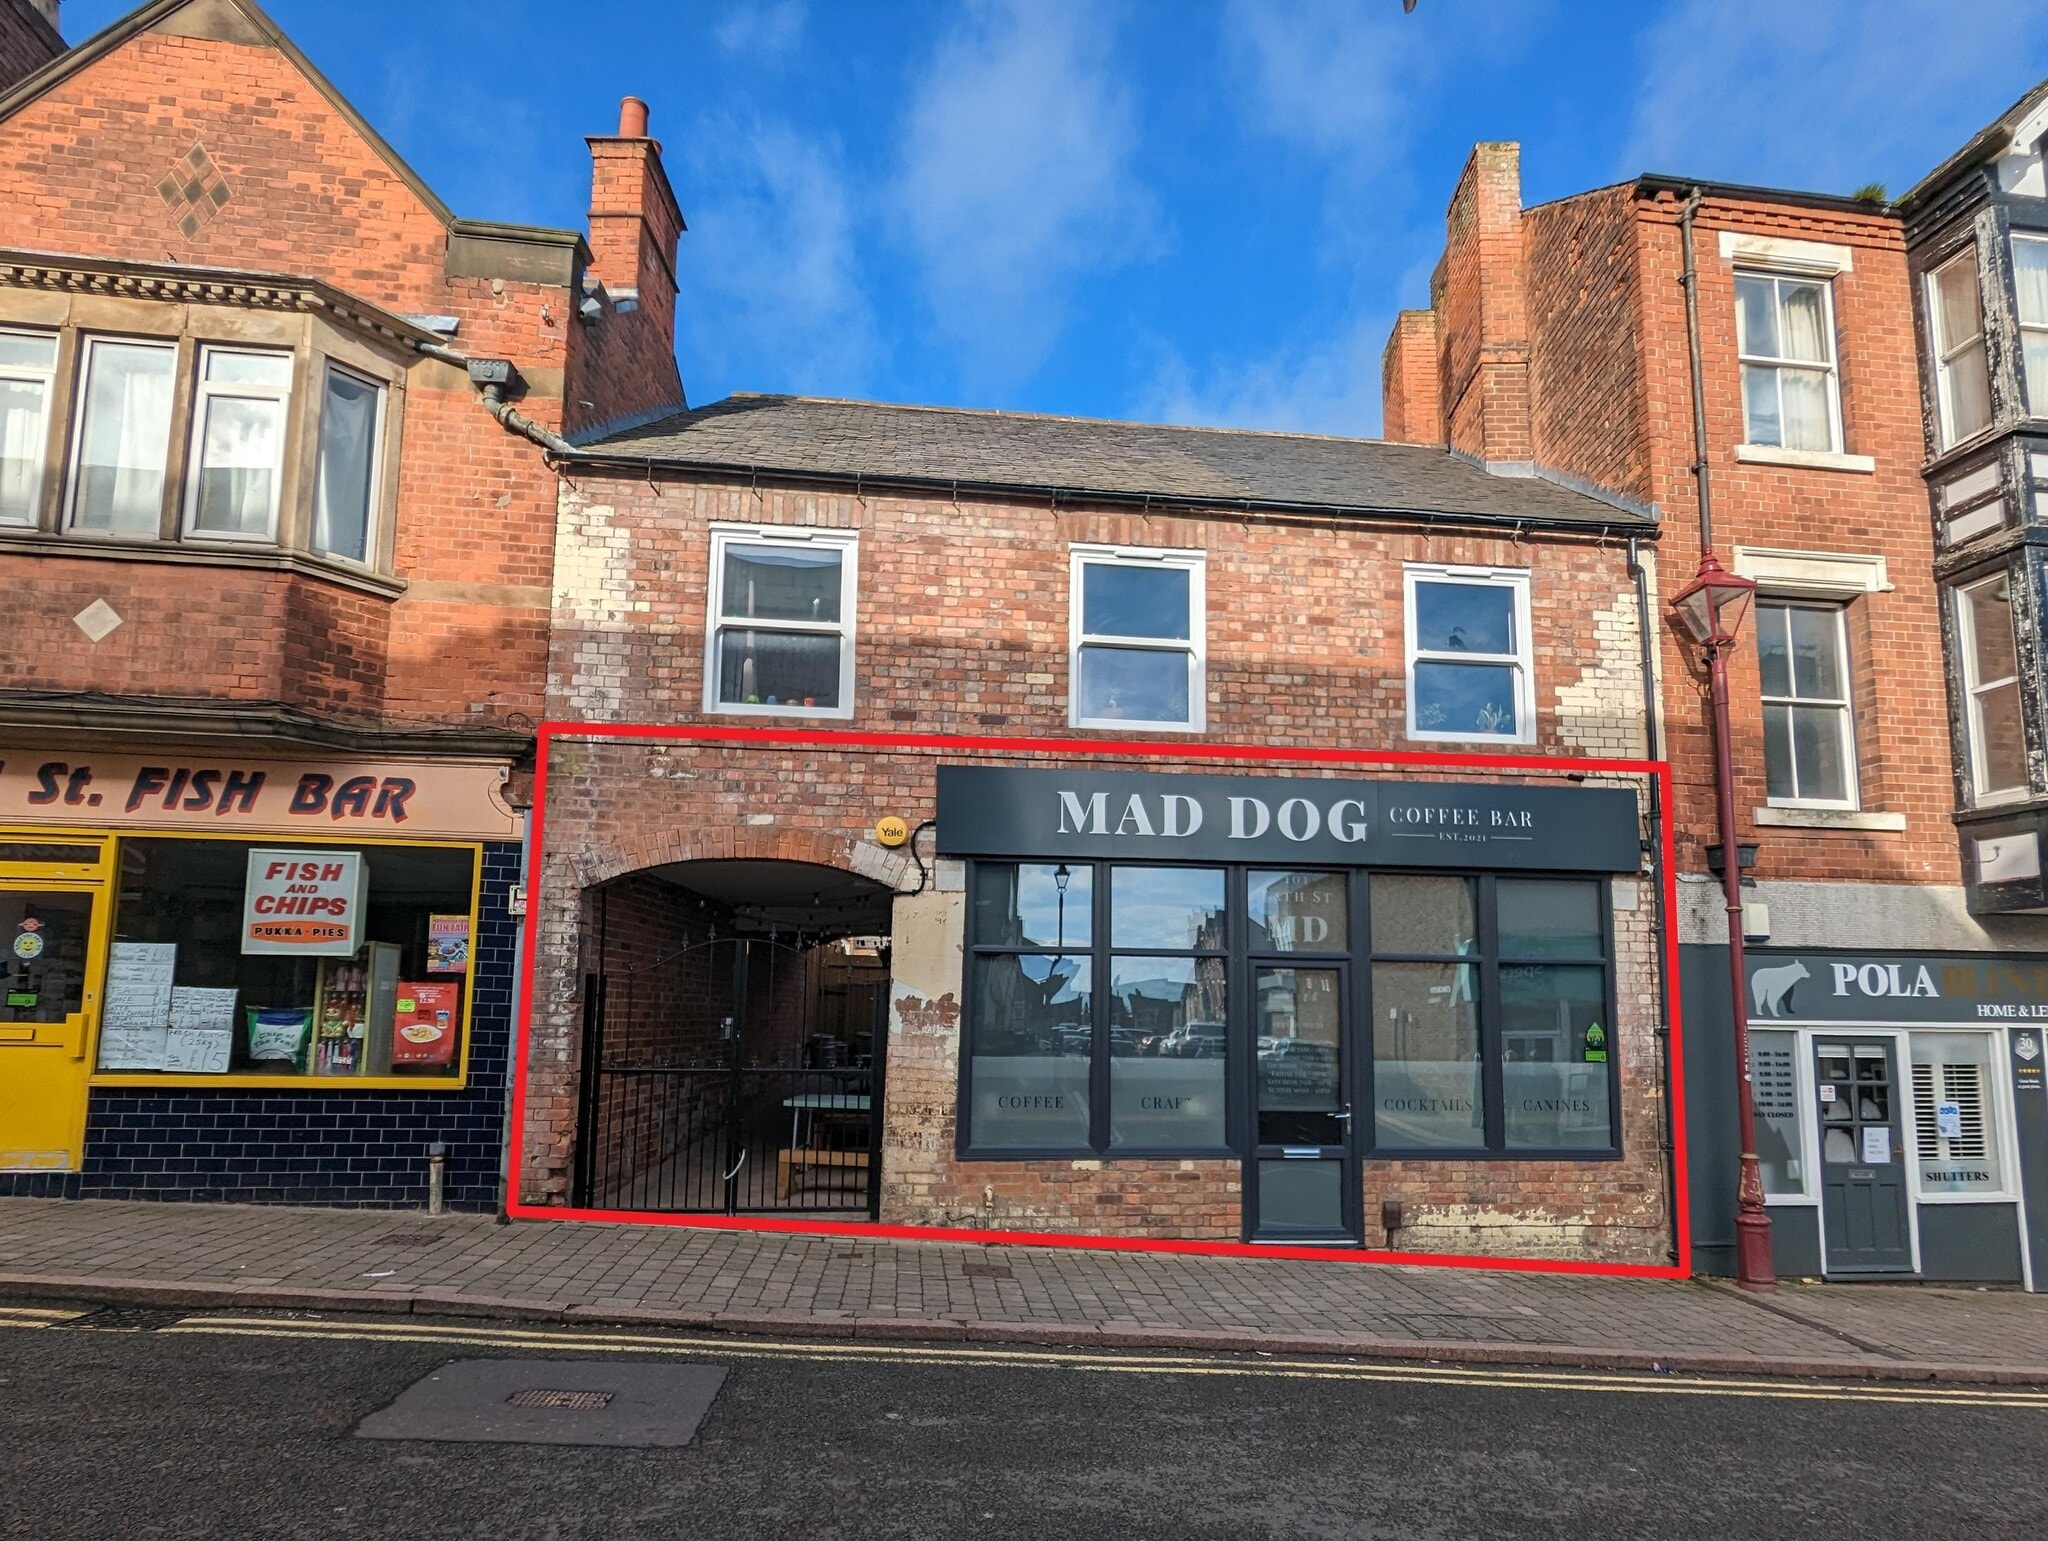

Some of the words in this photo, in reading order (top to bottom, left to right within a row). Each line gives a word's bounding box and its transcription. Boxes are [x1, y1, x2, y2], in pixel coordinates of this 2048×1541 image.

[28, 762, 103, 806] St.
[125, 766, 266, 816] FISH
[288, 773, 416, 823] BAR
[1056, 791, 1203, 837] MAD
[1227, 797, 1368, 842] DOG
[1389, 807, 1479, 825] COFFEE
[1490, 810, 1533, 827] BAR
[881, 827, 903, 837] Yale
[265, 862, 344, 882] FISH
[285, 884, 318, 894] AND
[254, 895, 347, 916] CHIPS
[1830, 963, 1940, 998] POLA
[1976, 1004, 2016, 1017] HOME
[2018, 1005, 2030, 1017] &
[2019, 1038, 2033, 1050] 30
[998, 1096, 1064, 1109] COFFEE
[1384, 1099, 1473, 1112] COCKTAILS
[1523, 1100, 1590, 1112] CANINES
[1926, 1171, 1989, 1182] SHUTTERS
